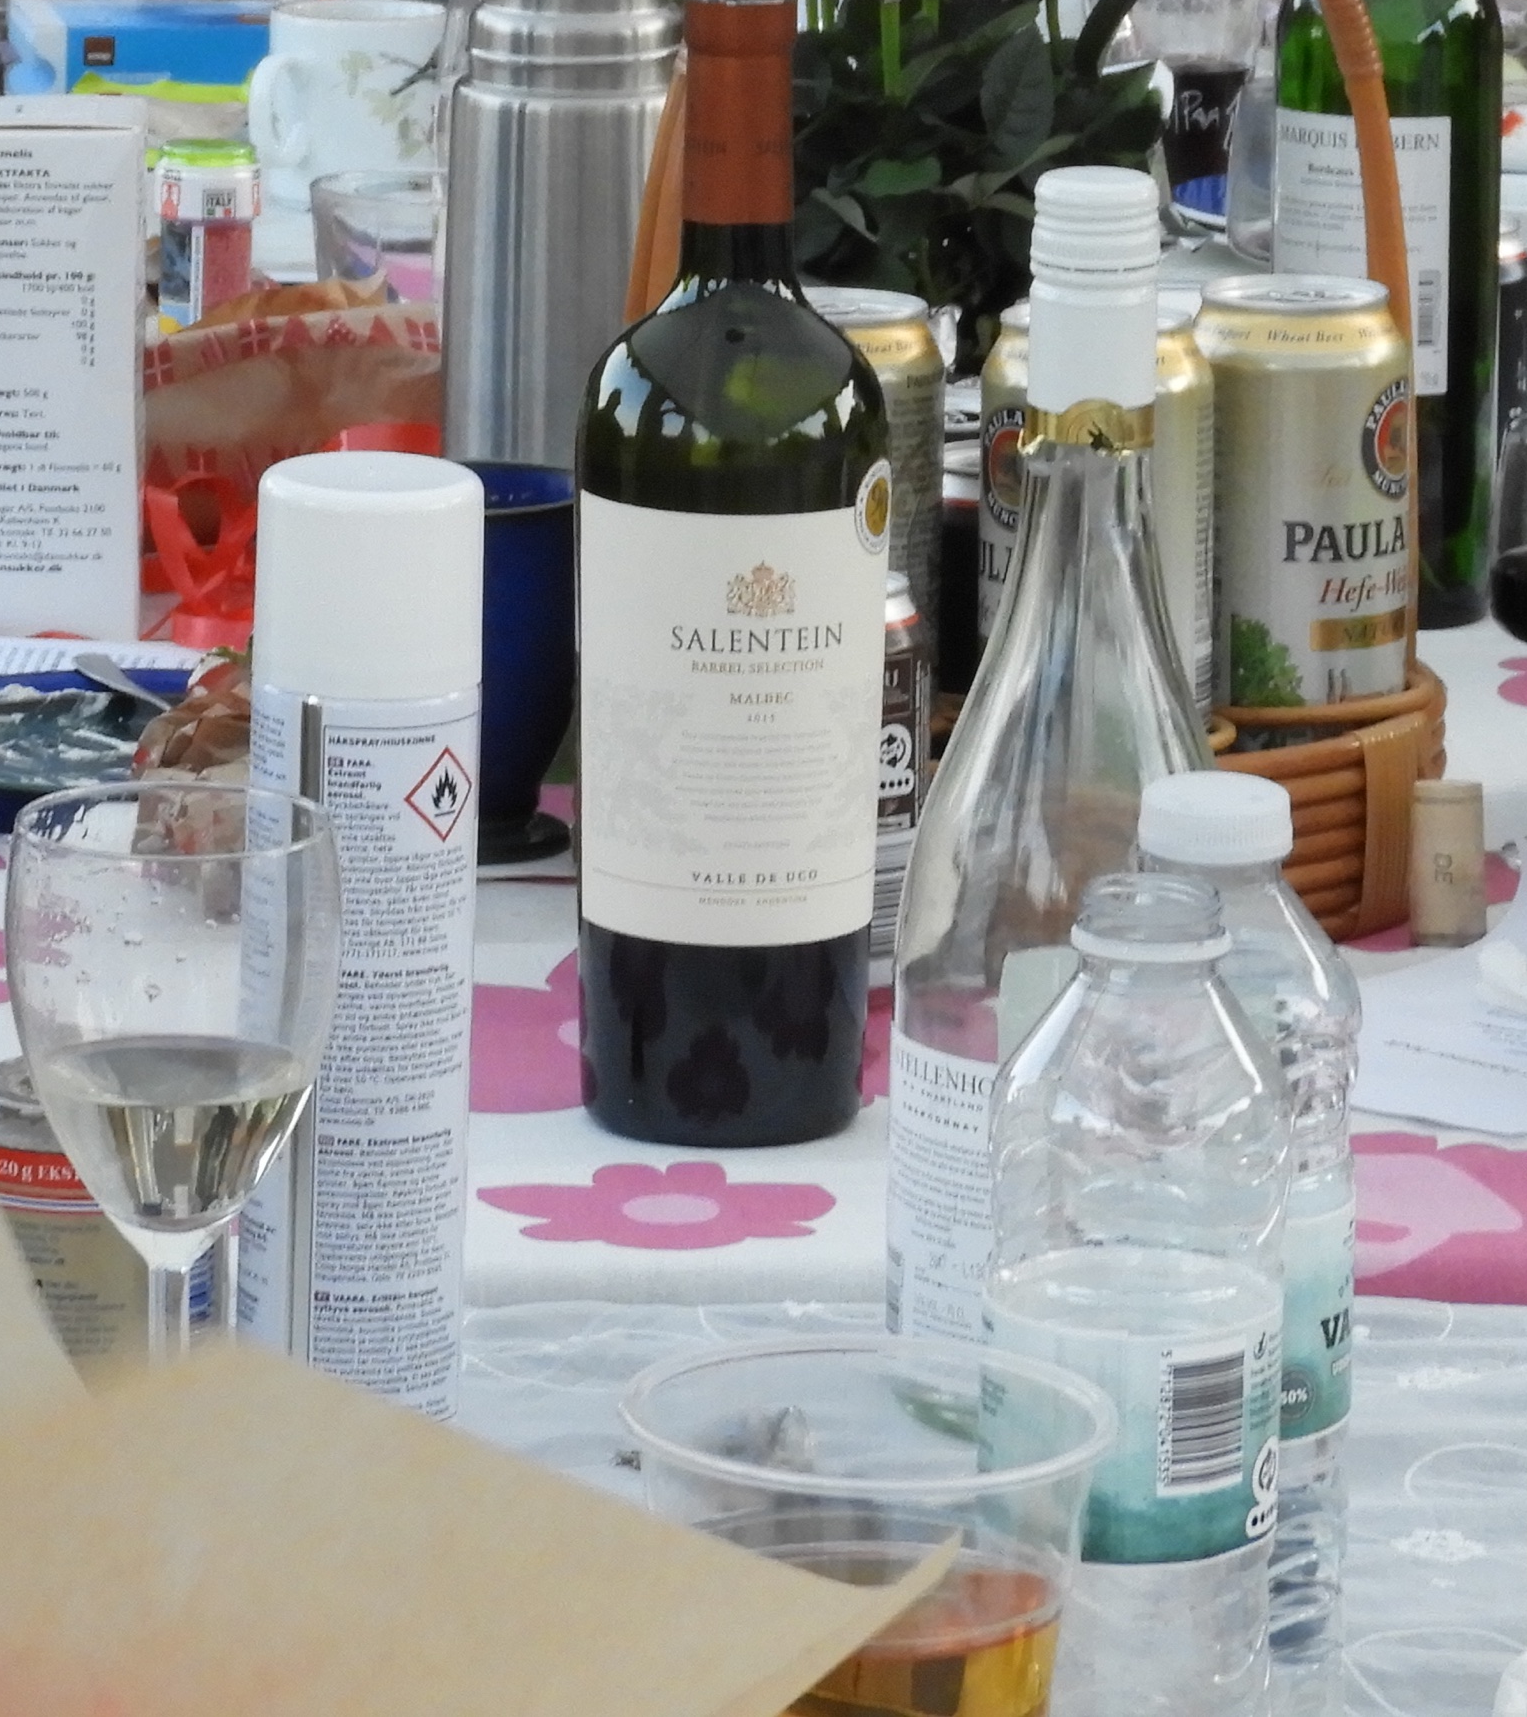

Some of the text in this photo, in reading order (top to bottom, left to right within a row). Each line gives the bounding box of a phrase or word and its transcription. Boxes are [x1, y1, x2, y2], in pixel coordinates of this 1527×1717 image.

[671, 622, 844, 654] SALENTEIN
[730, 690, 795, 706] MALBEC
[692, 871, 746, 885] VALLE
[755, 872, 778, 885] DE
[22, 1164, 33, 1183] g
